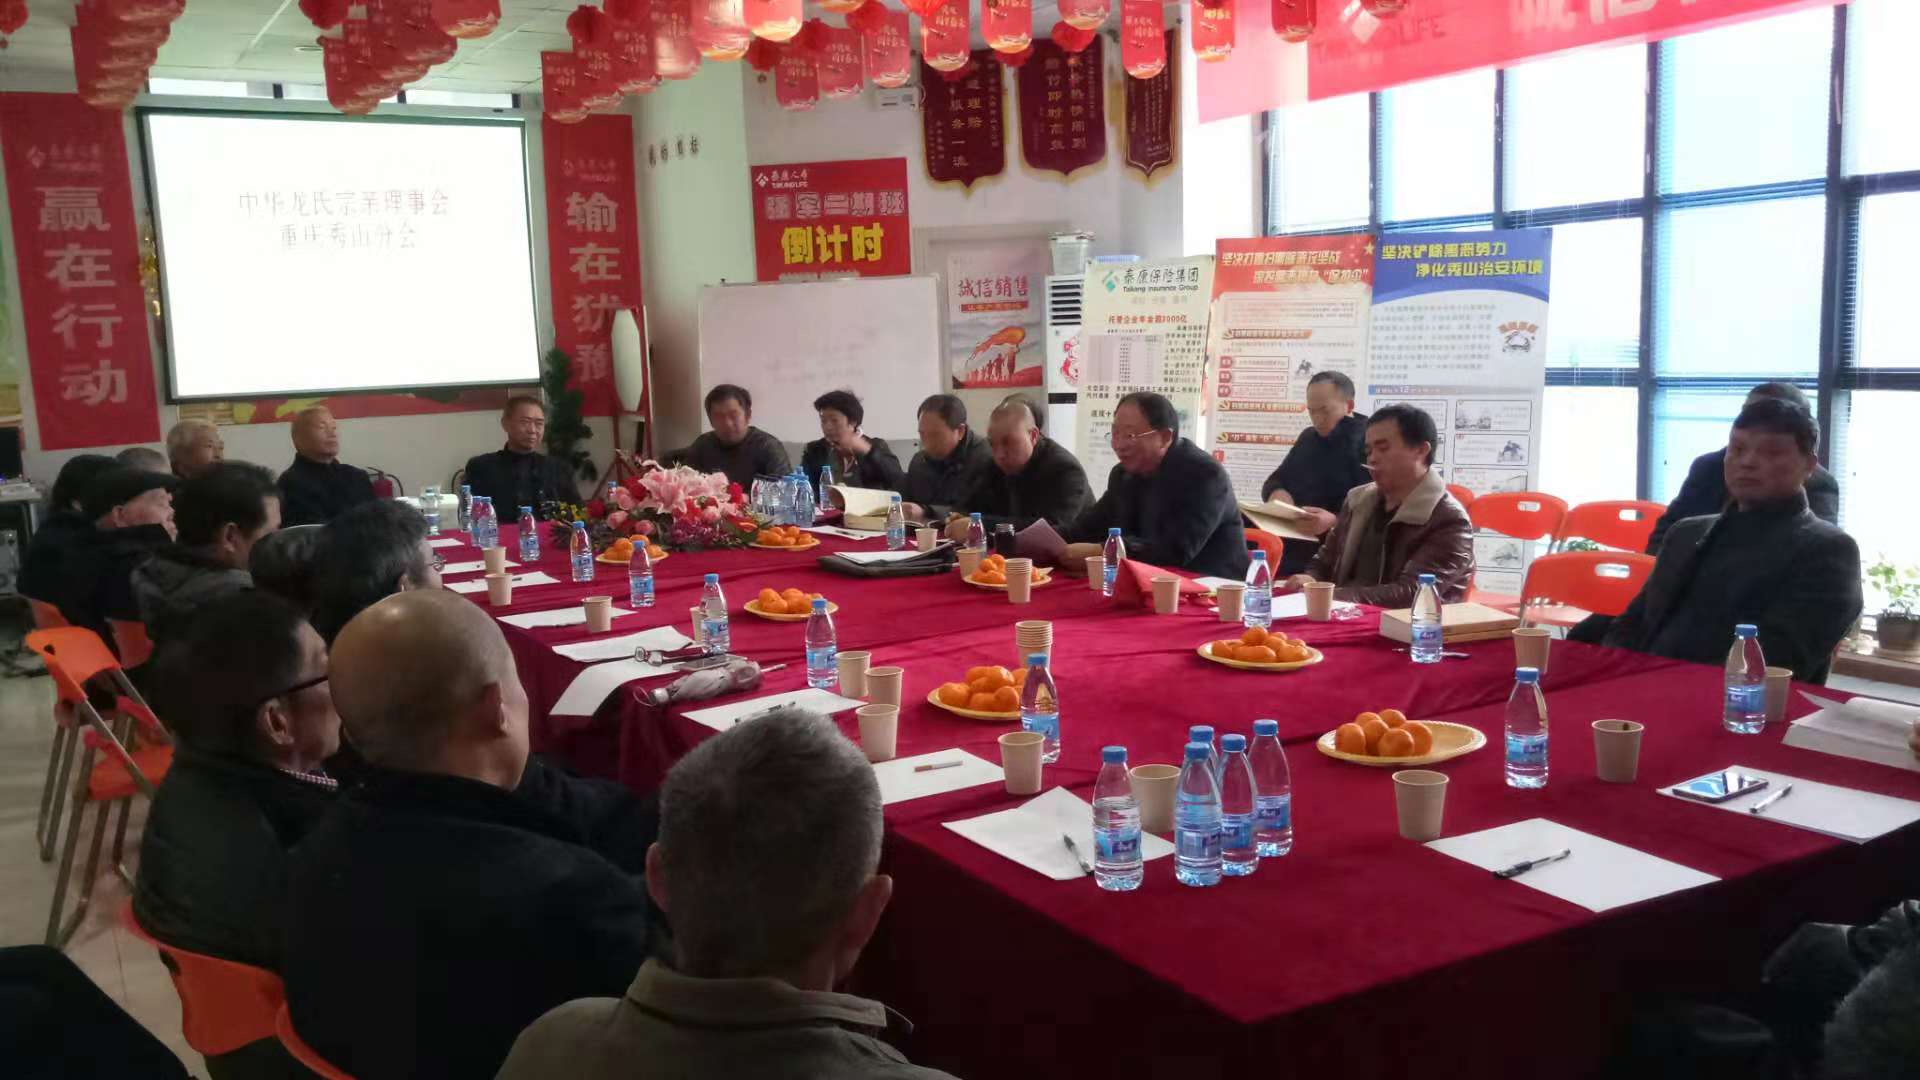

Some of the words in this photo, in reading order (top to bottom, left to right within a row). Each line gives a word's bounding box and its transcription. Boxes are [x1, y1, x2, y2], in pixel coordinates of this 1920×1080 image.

[782, 222, 884, 264] 倒计时
[1381, 242, 1507, 260] 坚决铲除黑恶势力
[1123, 267, 1199, 285] 泰康保险集团
[1416, 260, 1543, 278] 净化秀山治安环境
[35, 186, 128, 407] 赢在行动
